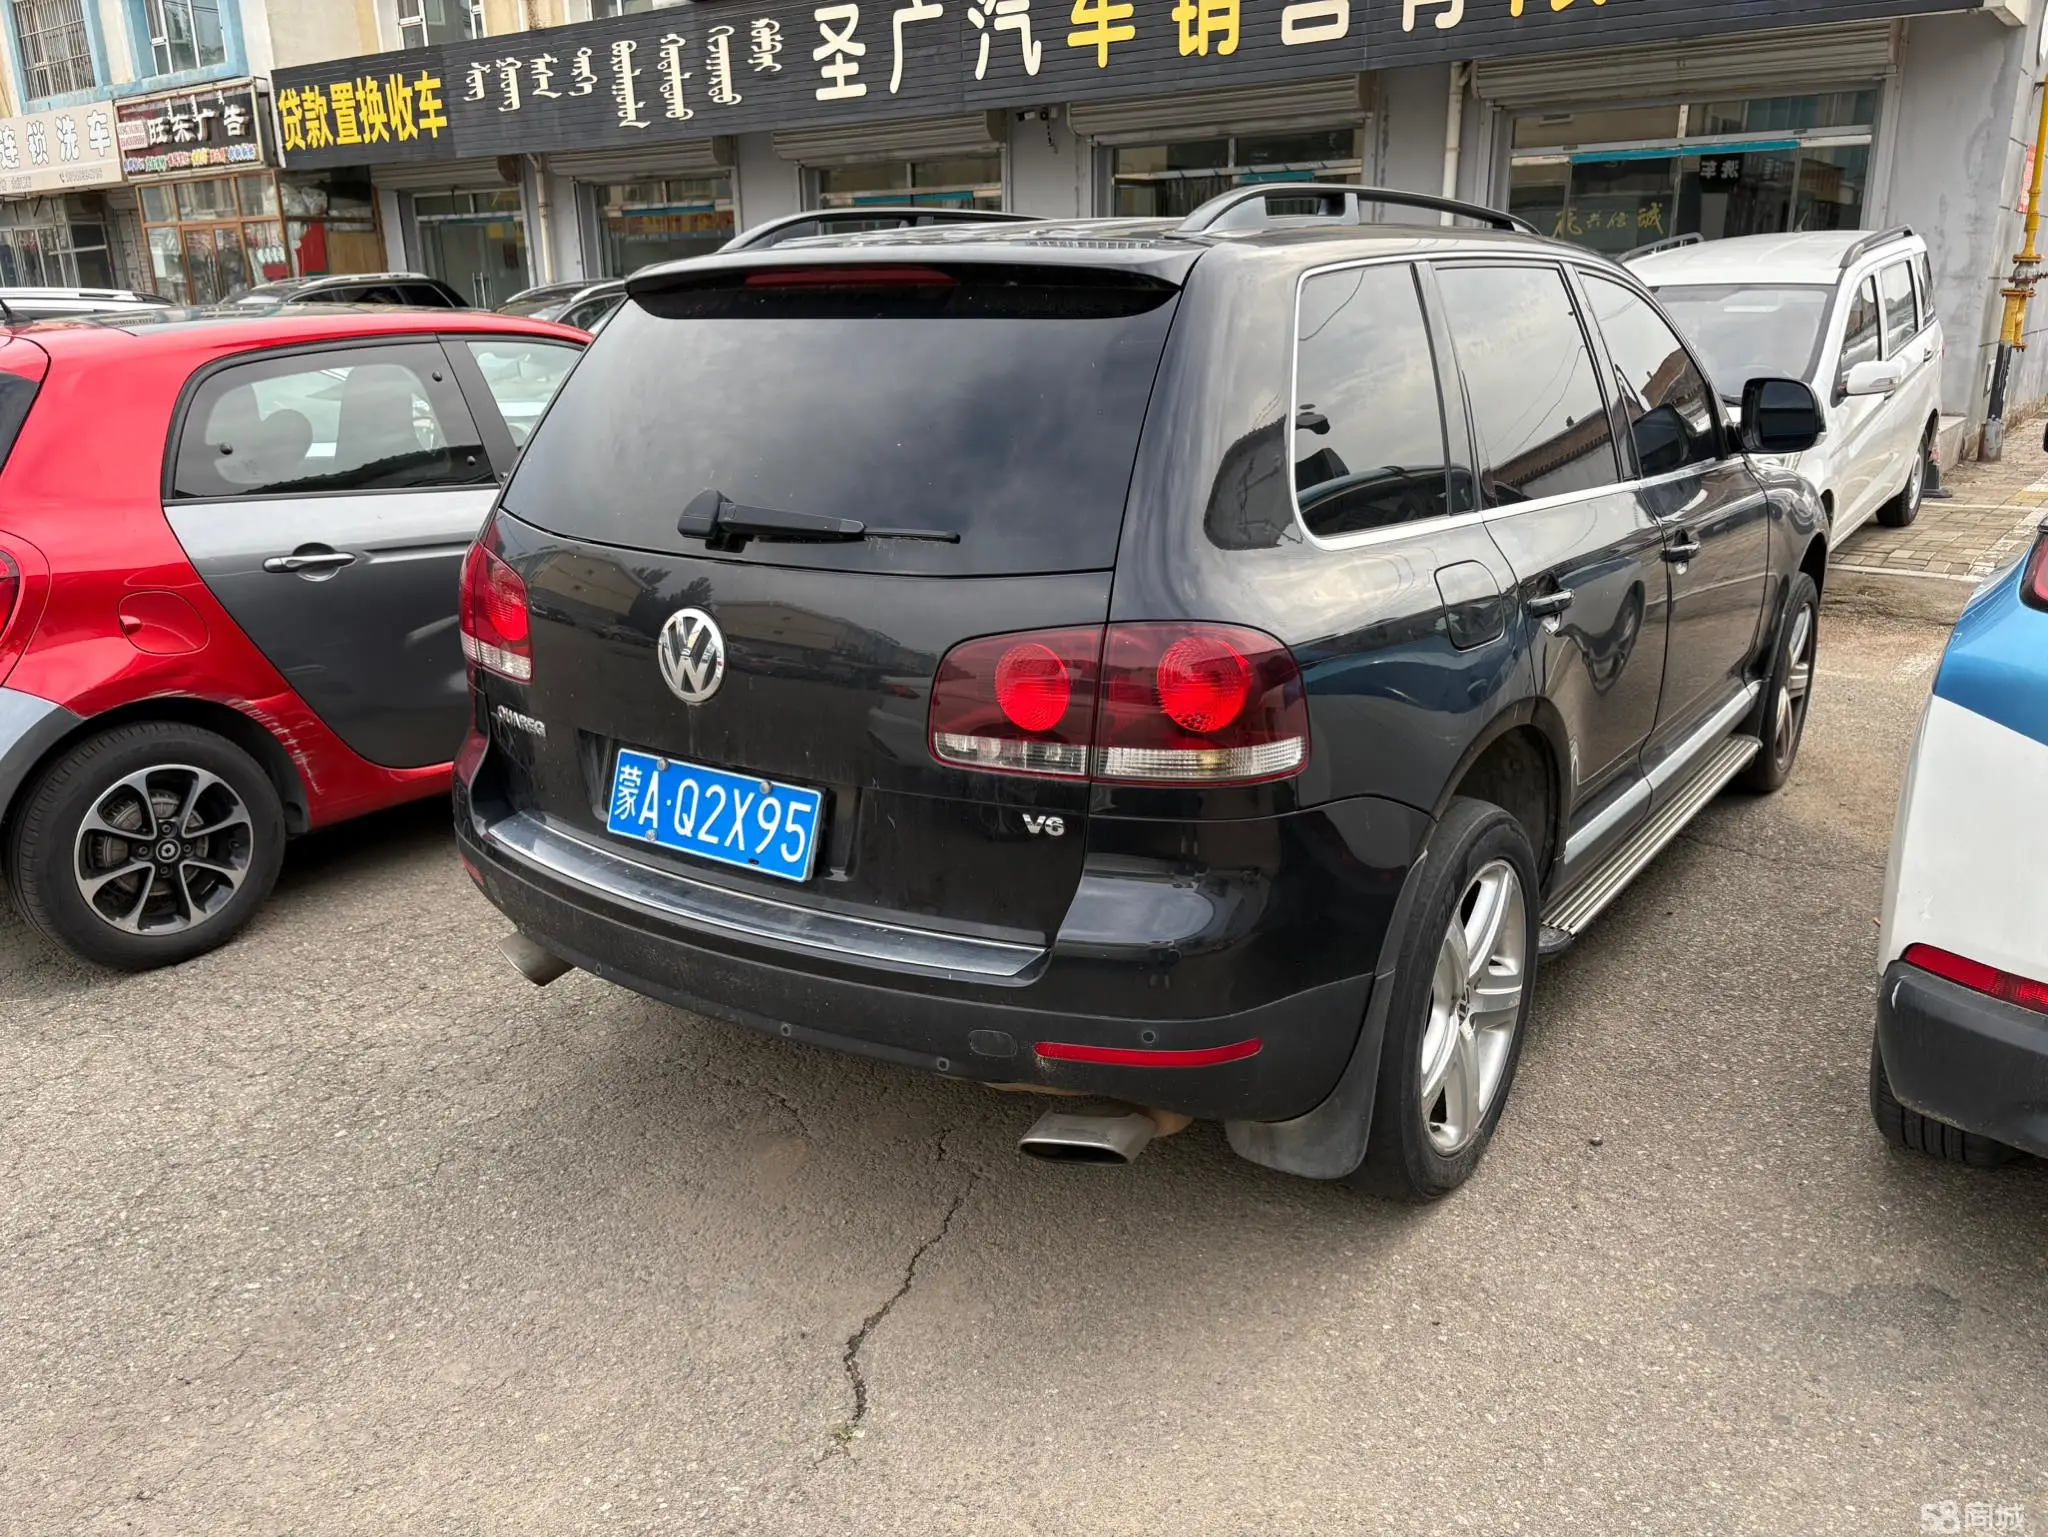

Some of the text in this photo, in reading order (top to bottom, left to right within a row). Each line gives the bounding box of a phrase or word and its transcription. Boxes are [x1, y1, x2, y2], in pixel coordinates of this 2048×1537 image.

[0, 110, 112, 169] 连锁洗车
[278, 70, 448, 151] 贷款置换收车
[613, 764, 812, 863] 蒙A·Q2X95
[1022, 813, 1065, 837] V6
